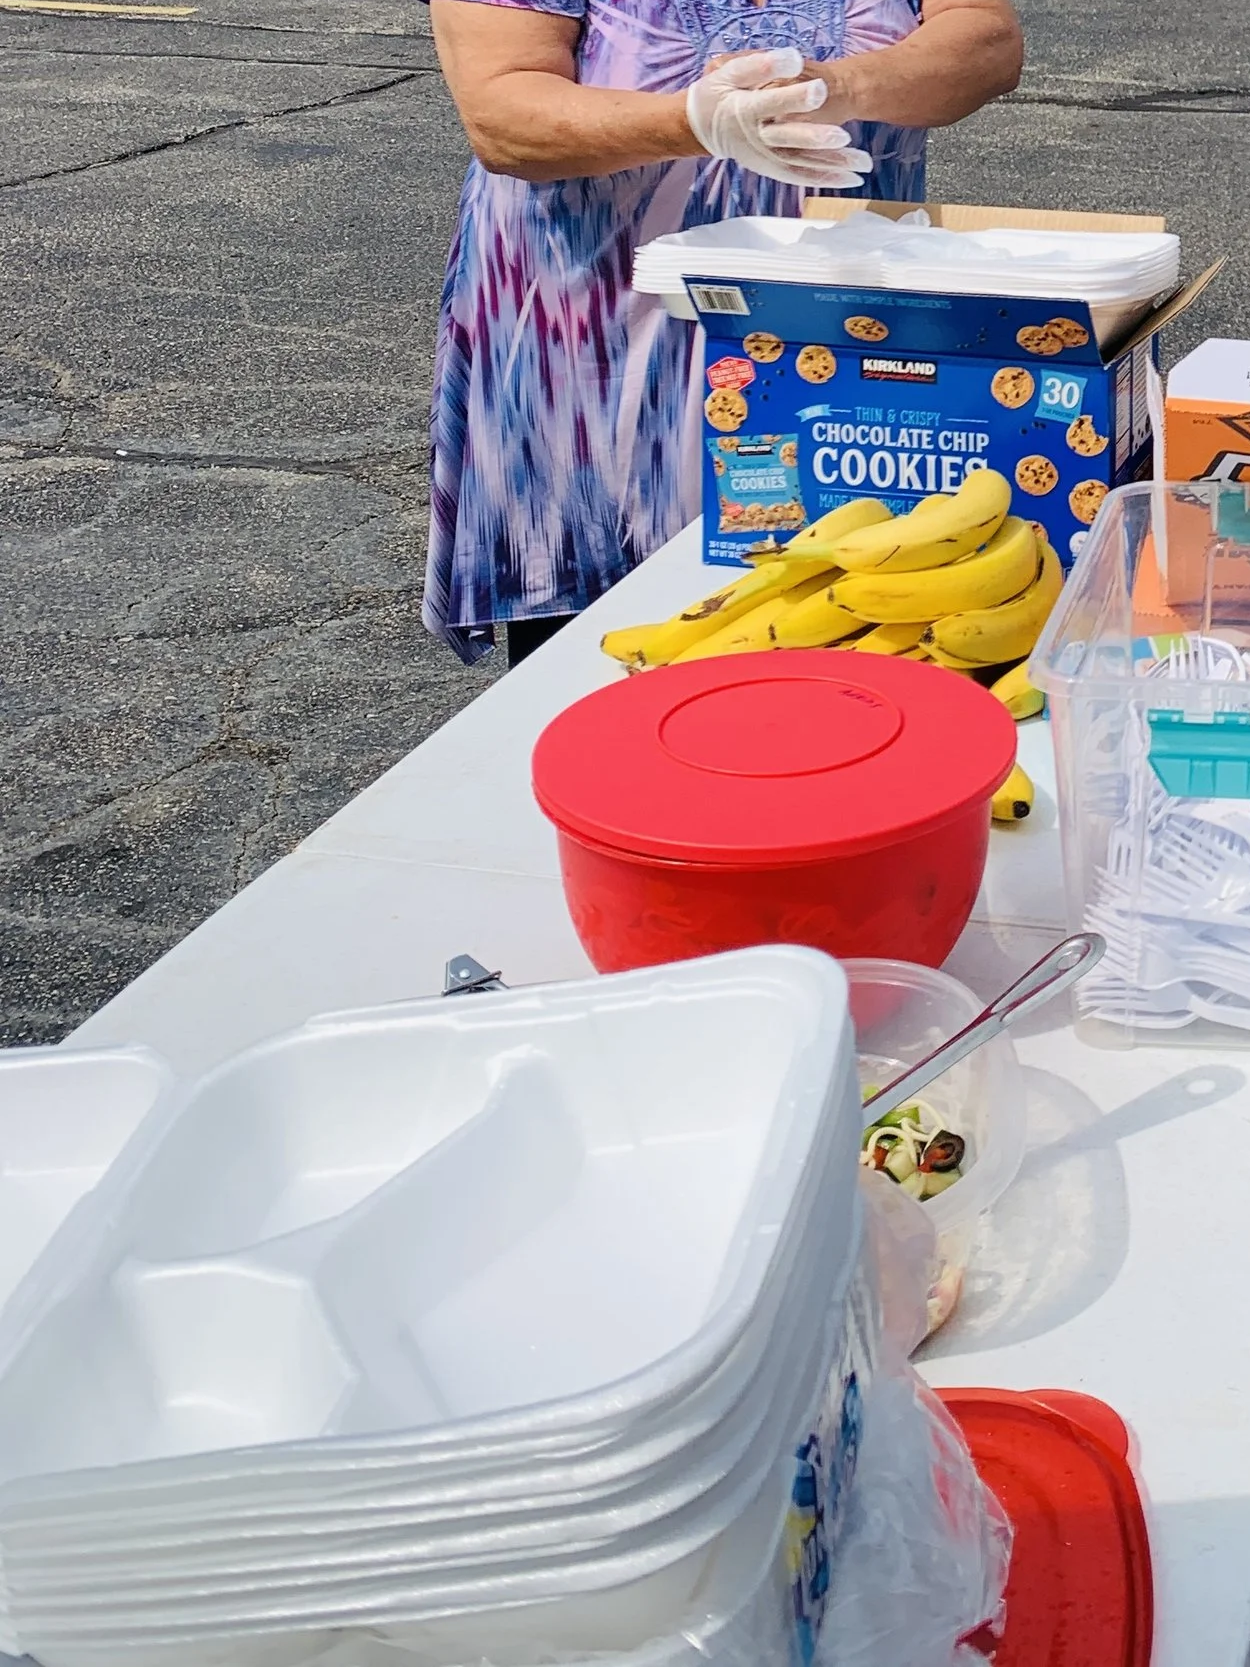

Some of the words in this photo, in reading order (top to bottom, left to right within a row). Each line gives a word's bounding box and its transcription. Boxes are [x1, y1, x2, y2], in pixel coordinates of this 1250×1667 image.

[863, 358, 936, 376] KIRKLAND
[1043, 377, 1080, 409] 30
[854, 406, 884, 423] THIN
[887, 408, 896, 424] &
[900, 410, 941, 427] CRISPY
[811, 422, 935, 450] CHOCOLATE
[938, 430, 990, 453] CHIP
[731, 475, 788, 491] COOKIES
